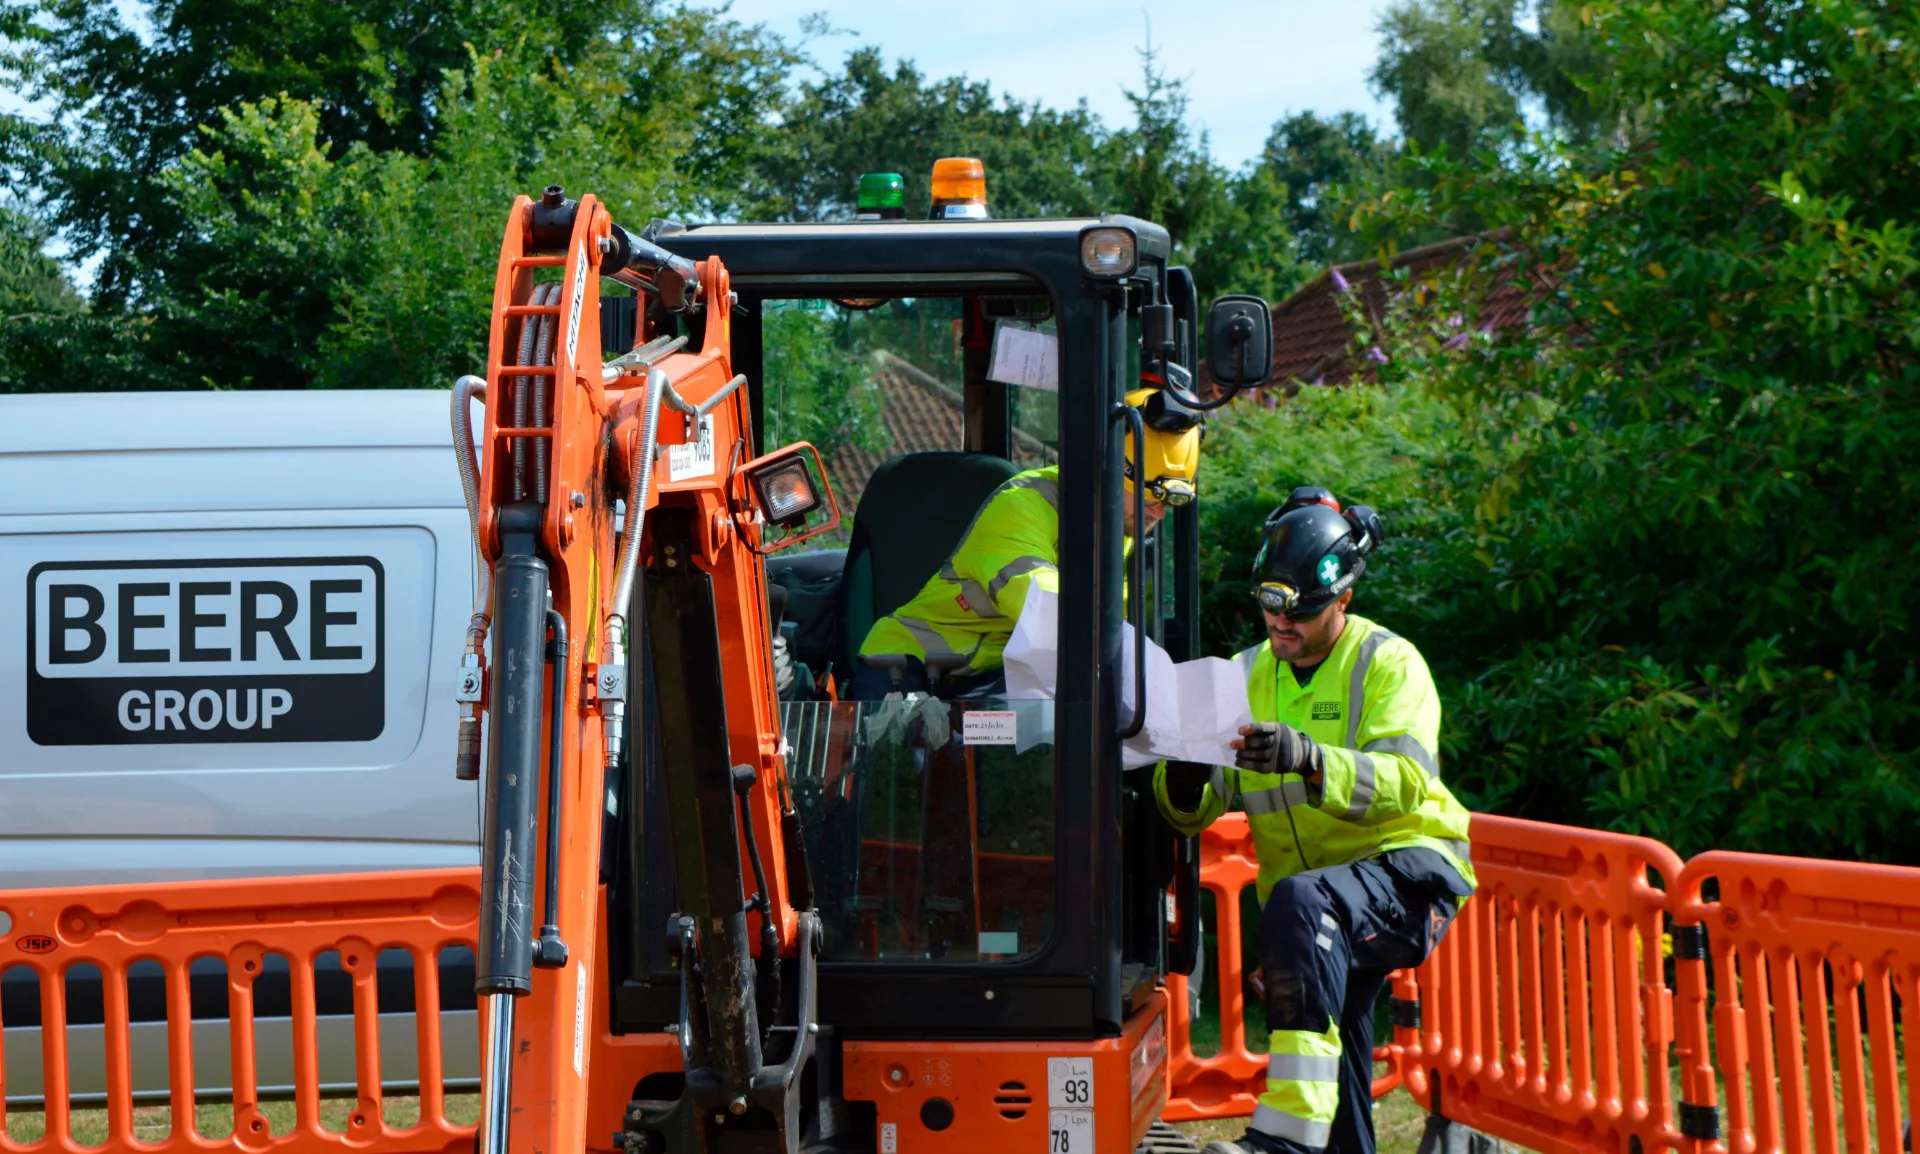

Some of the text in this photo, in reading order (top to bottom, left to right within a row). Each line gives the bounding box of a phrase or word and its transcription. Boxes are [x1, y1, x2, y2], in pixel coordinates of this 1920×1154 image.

[569, 252, 586, 356] HITACHI
[49, 579, 362, 664] BEERE
[118, 688, 293, 731] GROUP
[1313, 703, 1340, 712] BEERE
[24, 939, 52, 950] JSP
[1065, 1080, 1089, 1103] 93
[1051, 1129, 1069, 1153] 78
